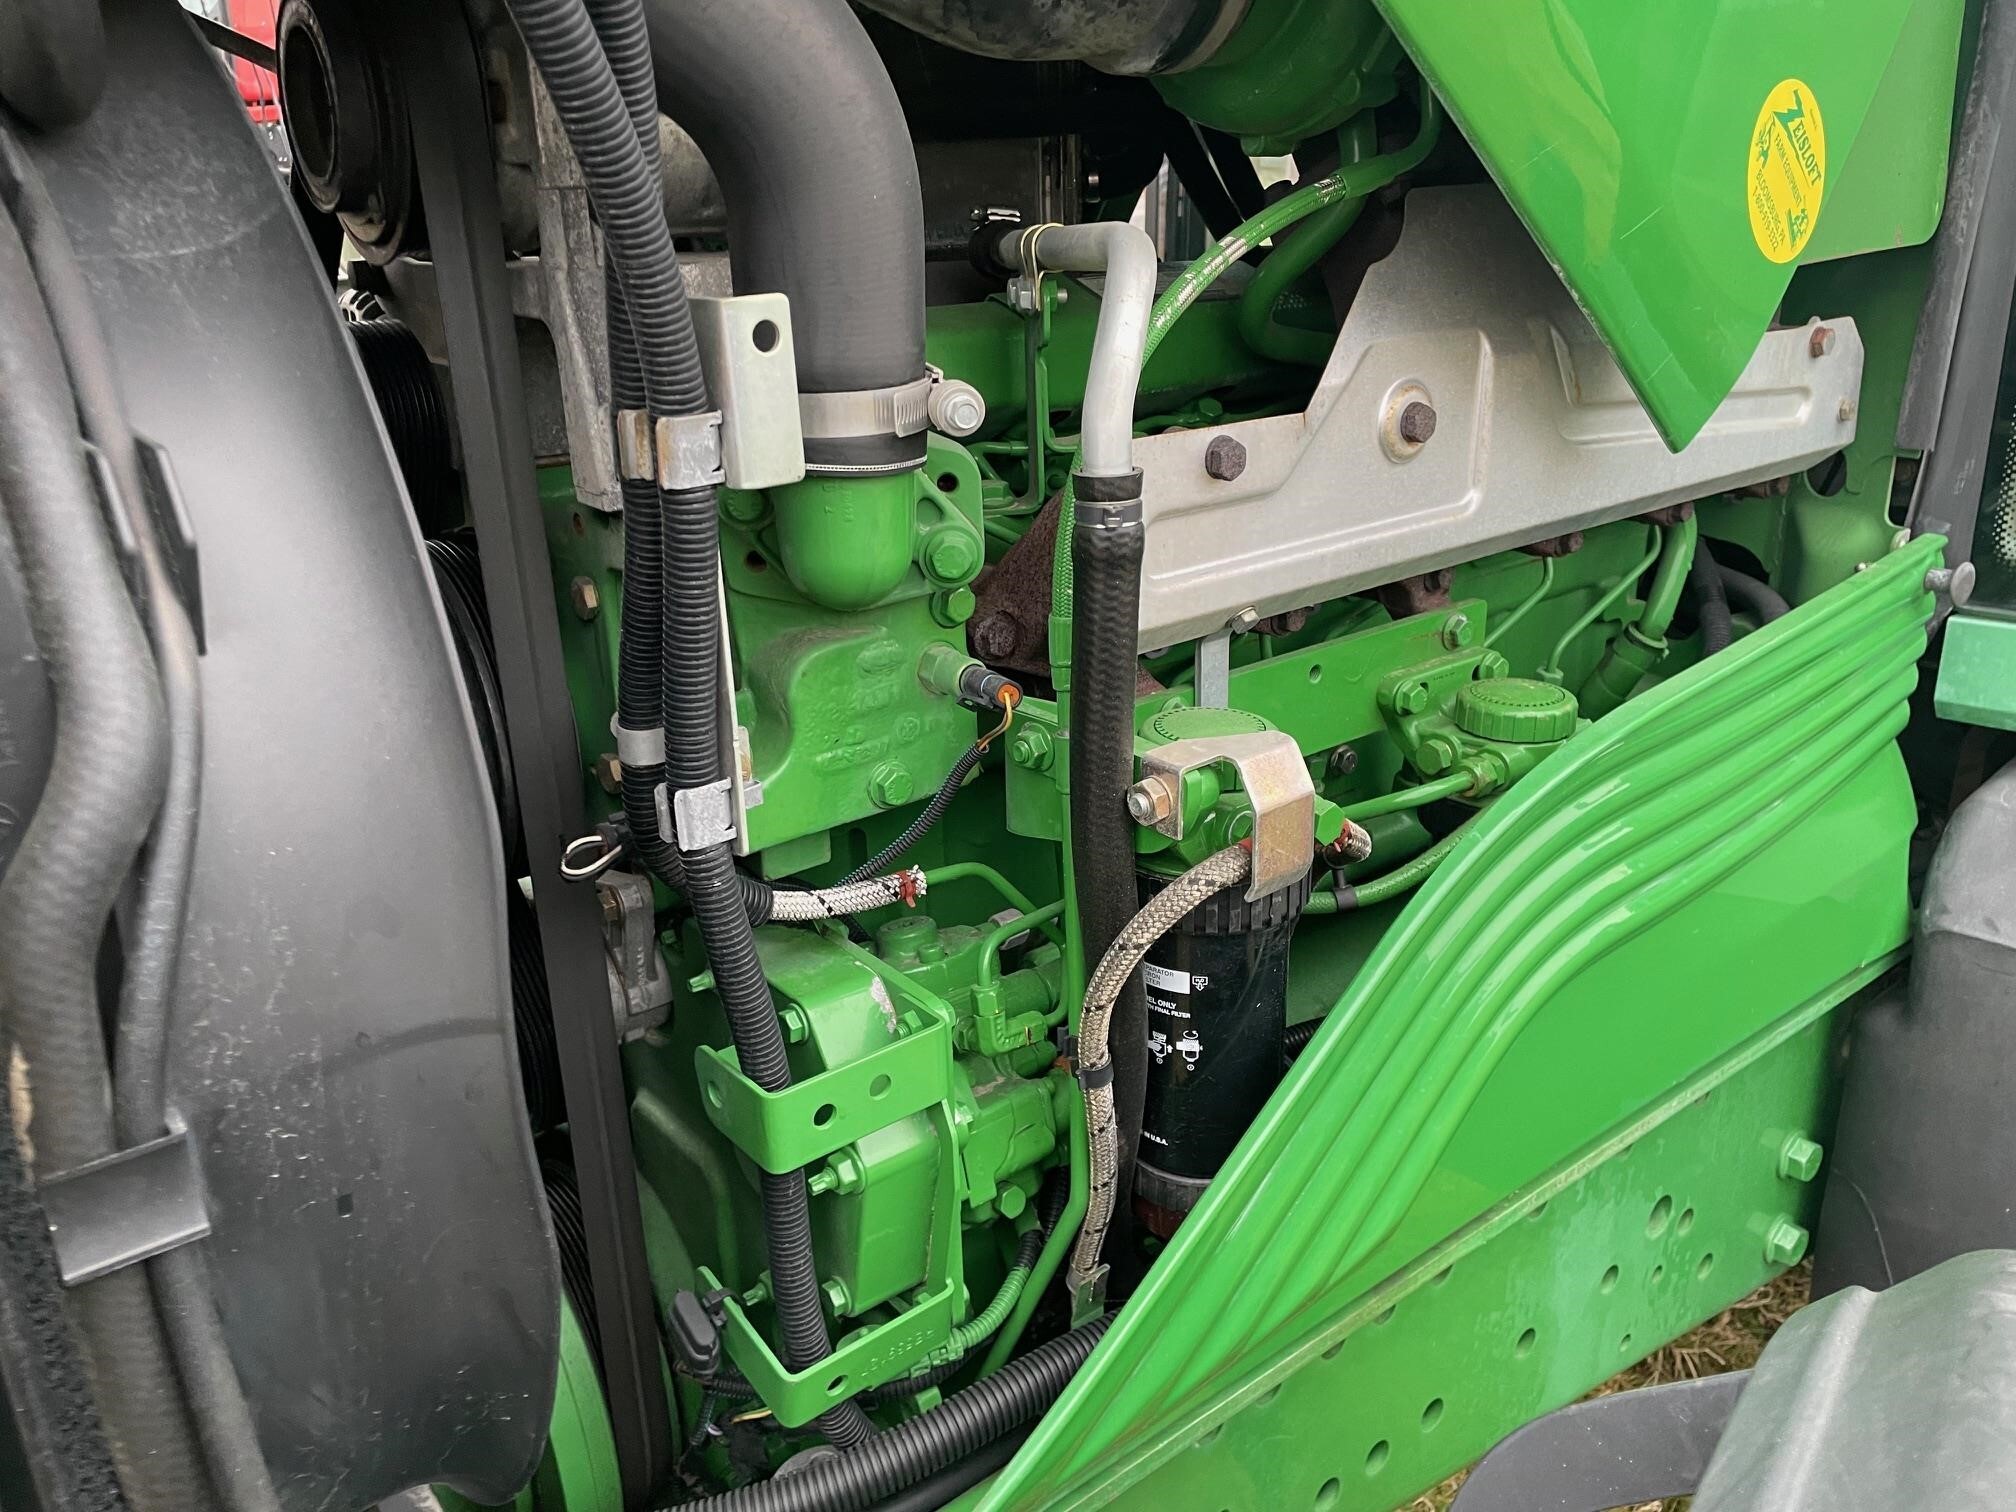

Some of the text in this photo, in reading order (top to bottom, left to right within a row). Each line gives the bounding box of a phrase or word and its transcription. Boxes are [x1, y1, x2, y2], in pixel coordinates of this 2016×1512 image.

[1772, 88, 1822, 187] ZEISLOFT
[1774, 133, 1802, 208] FARM EQUIPMENT
[1145, 964, 1174, 977] PARATOR
[1157, 999, 1177, 1010] ONLY
[1154, 1005, 1170, 1016] FINAL
[1170, 1010, 1191, 1019] FILTER
